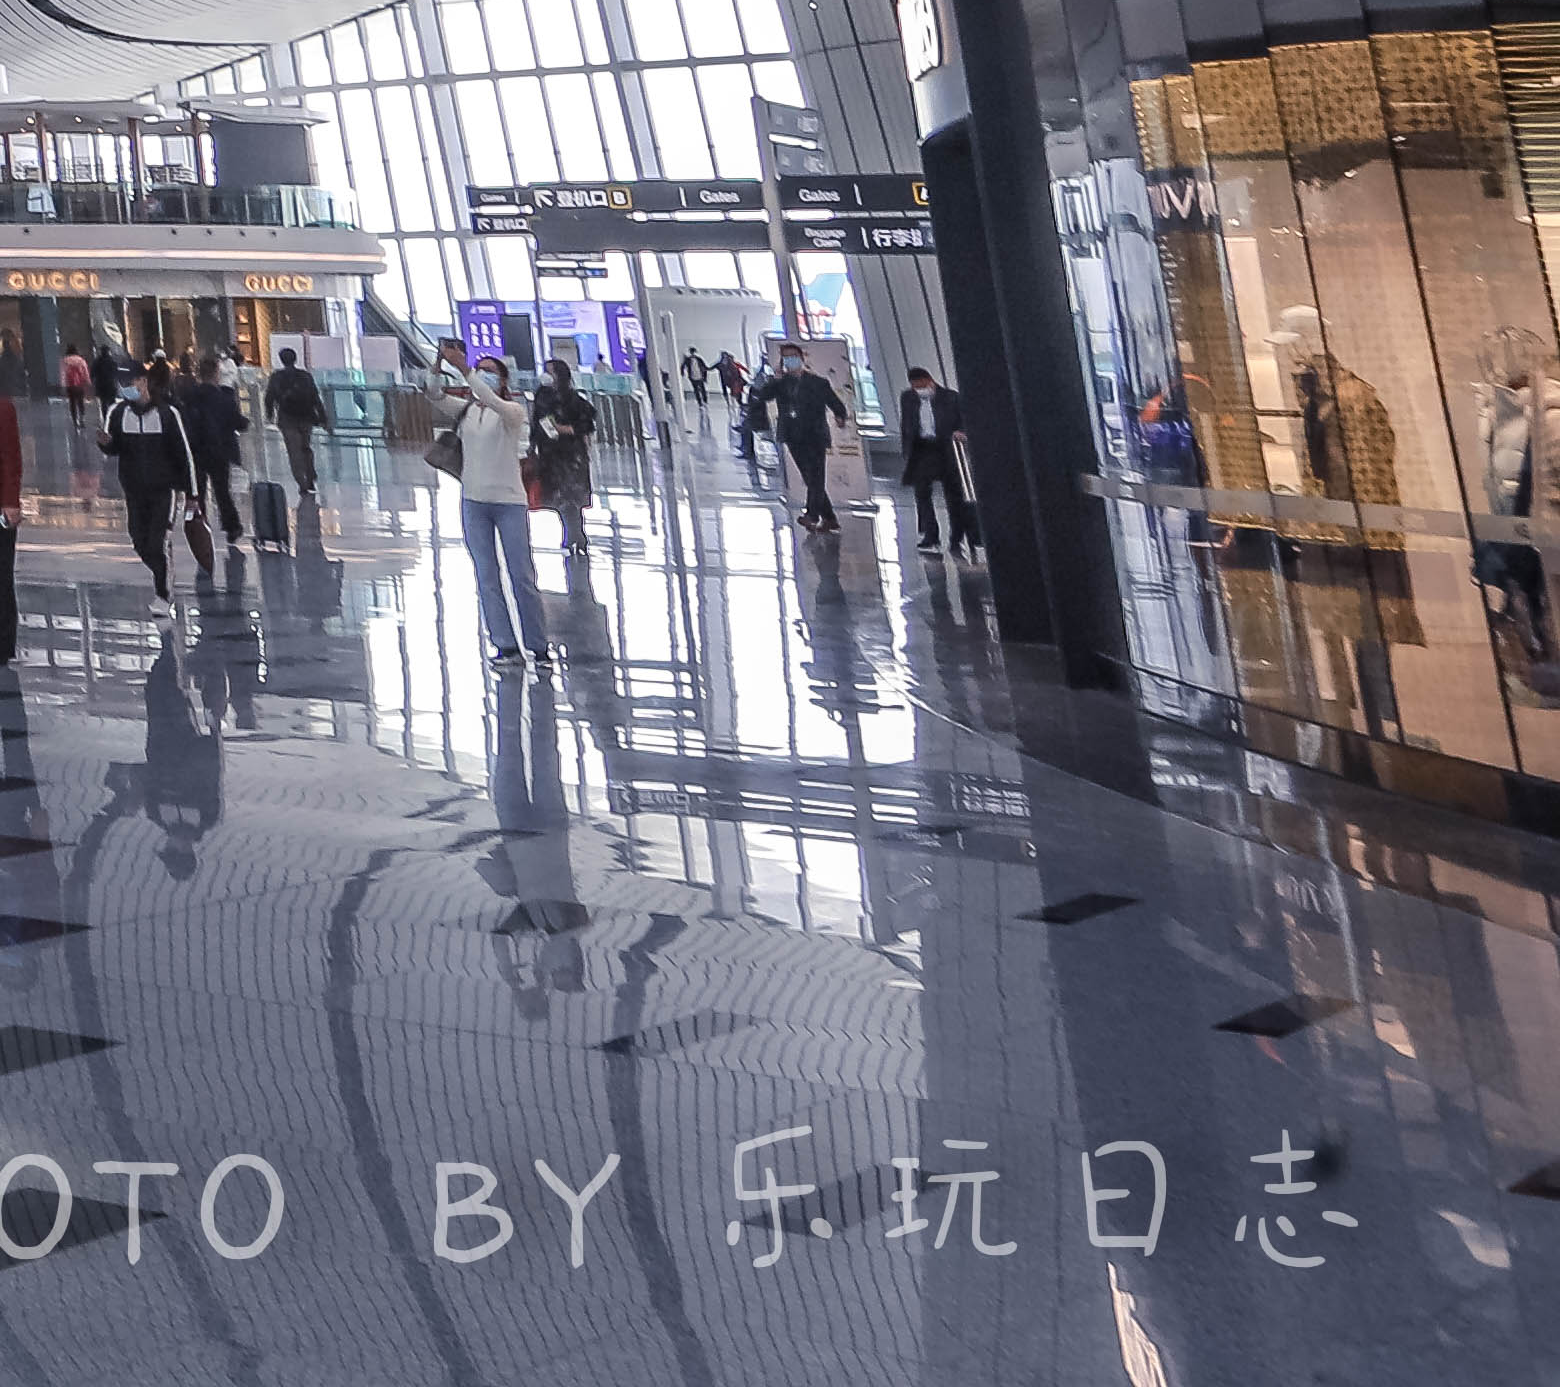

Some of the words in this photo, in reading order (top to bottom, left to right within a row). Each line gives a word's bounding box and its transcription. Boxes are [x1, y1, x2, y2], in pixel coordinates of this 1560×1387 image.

[555, 189, 608, 208] 登机口
[699, 190, 741, 204] Gates
[798, 188, 841, 203] Gates
[7, 270, 100, 291] GUCCI
[244, 273, 313, 293] GUCCI
